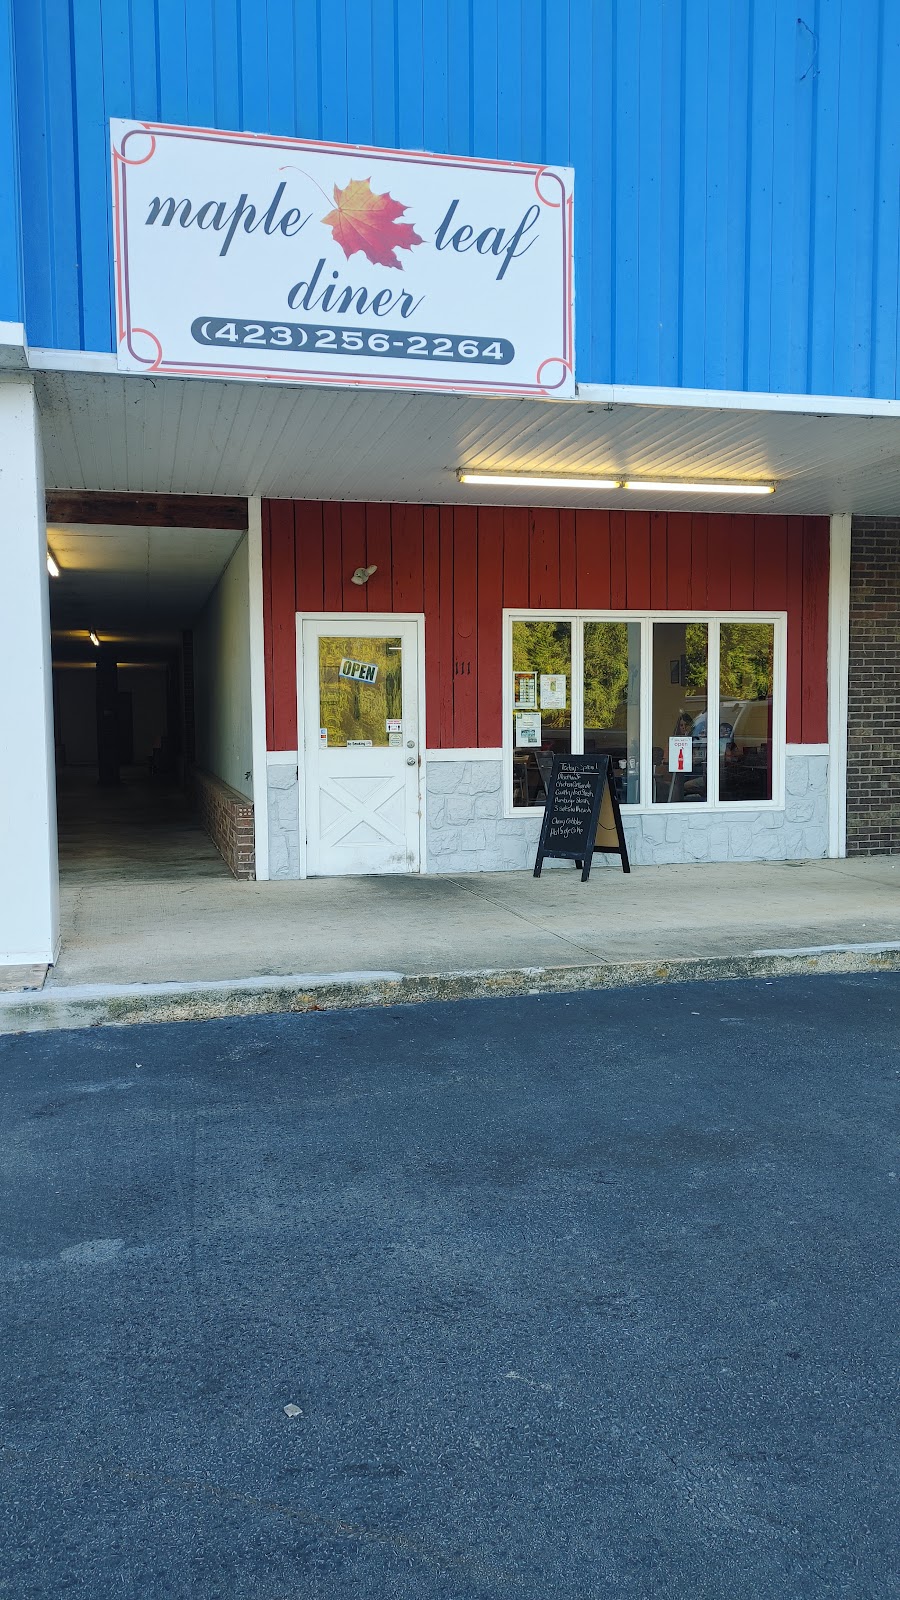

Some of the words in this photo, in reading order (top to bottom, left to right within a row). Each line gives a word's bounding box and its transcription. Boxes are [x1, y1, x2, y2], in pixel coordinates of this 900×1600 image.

[145, 181, 313, 257] maple
[434, 199, 540, 281] leaf
[287, 258, 426, 319] diner
[200, 320, 505, 360] (423)256-2264
[342, 660, 376, 682] OPEN
[455, 661, 471, 676] 111
